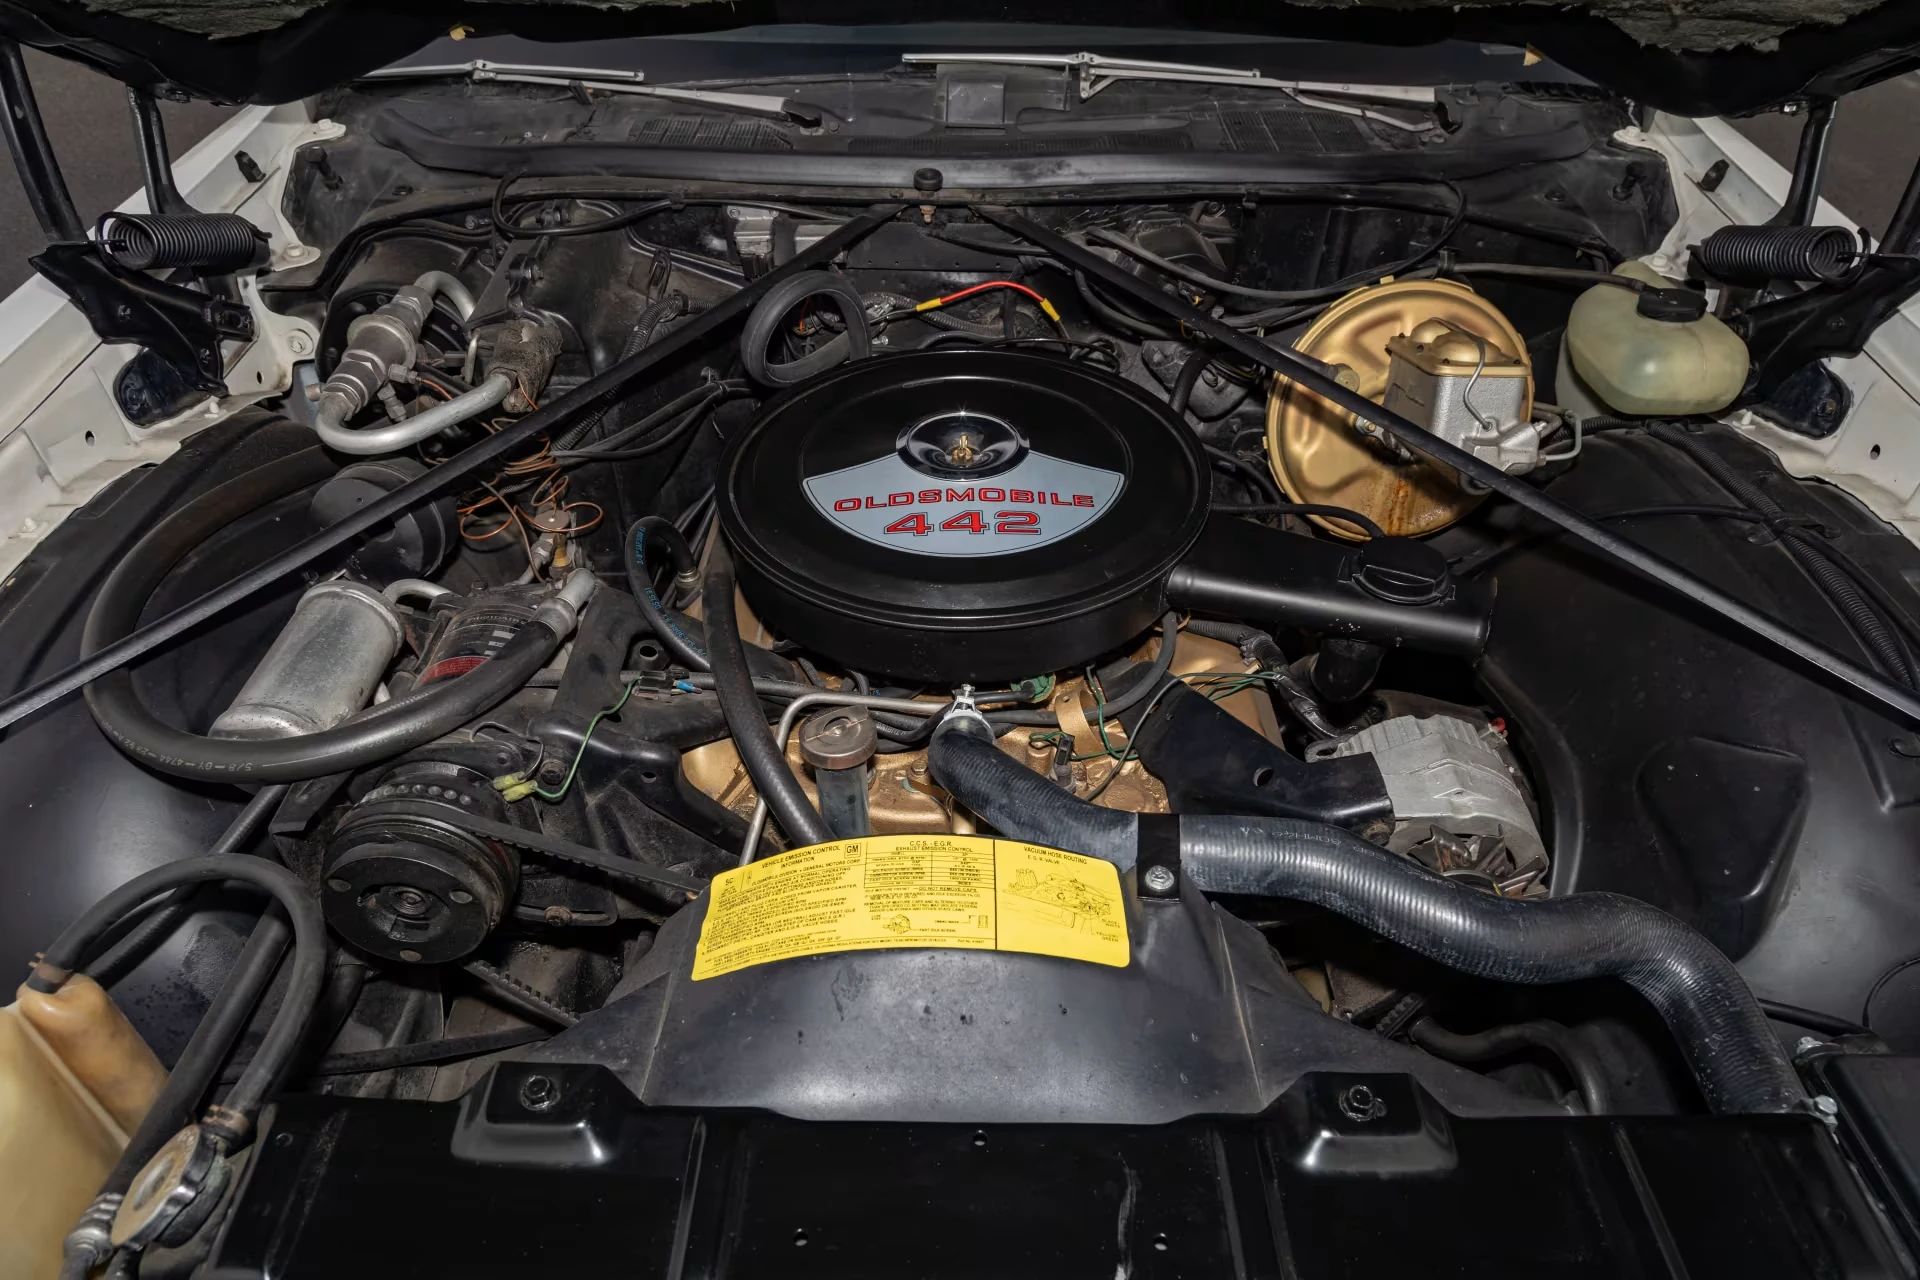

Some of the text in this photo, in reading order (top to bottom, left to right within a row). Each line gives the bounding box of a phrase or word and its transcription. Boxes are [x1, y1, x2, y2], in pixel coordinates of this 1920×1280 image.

[833, 487, 1095, 512] OLDSMOBILE
[883, 509, 1042, 536] 442
[762, 845, 840, 868] VEHICLE EMISSION CONTROL
[846, 845, 859, 854] GM
[1023, 846, 1046, 855] VACUUM
[1064, 855, 1087, 864] ROUTING
[781, 856, 814, 868] INFORMATION
